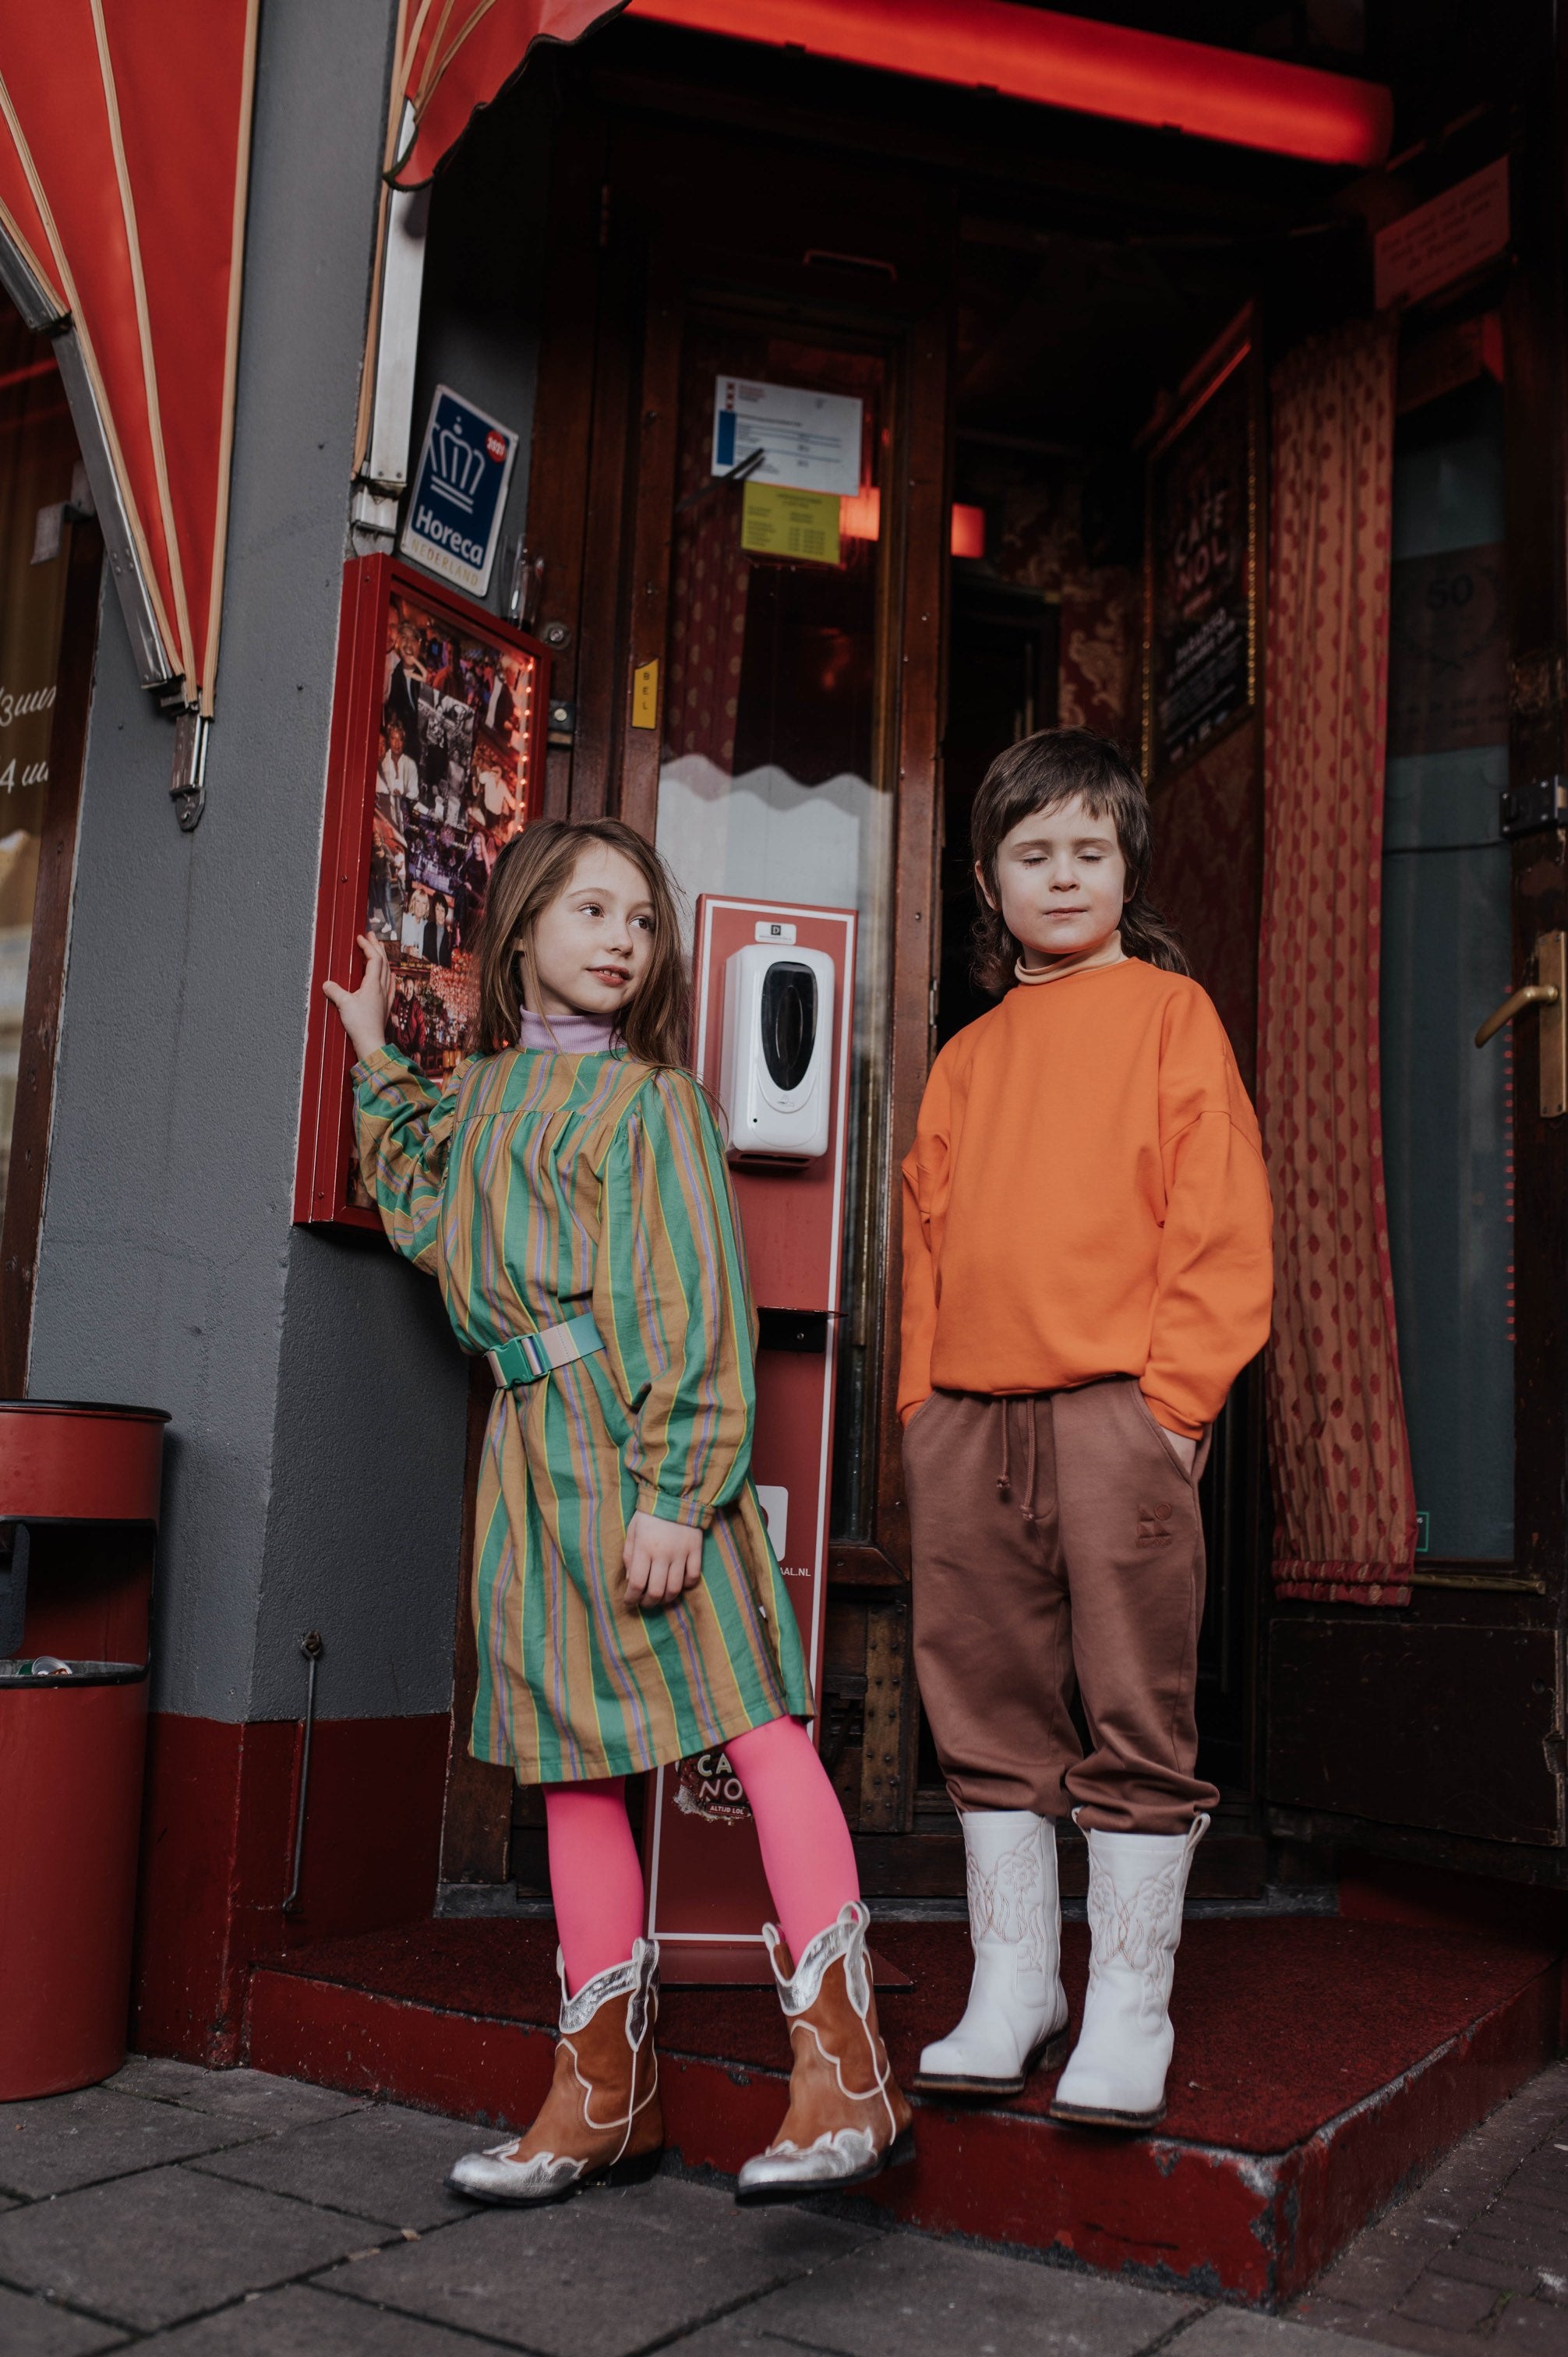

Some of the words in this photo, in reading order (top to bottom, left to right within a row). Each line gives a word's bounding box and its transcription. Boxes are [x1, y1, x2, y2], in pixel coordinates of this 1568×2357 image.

[415, 504, 484, 566] Horeca
[411, 538, 479, 588] NEDERLAND
[710, 1804, 731, 1814] ALTIJD
